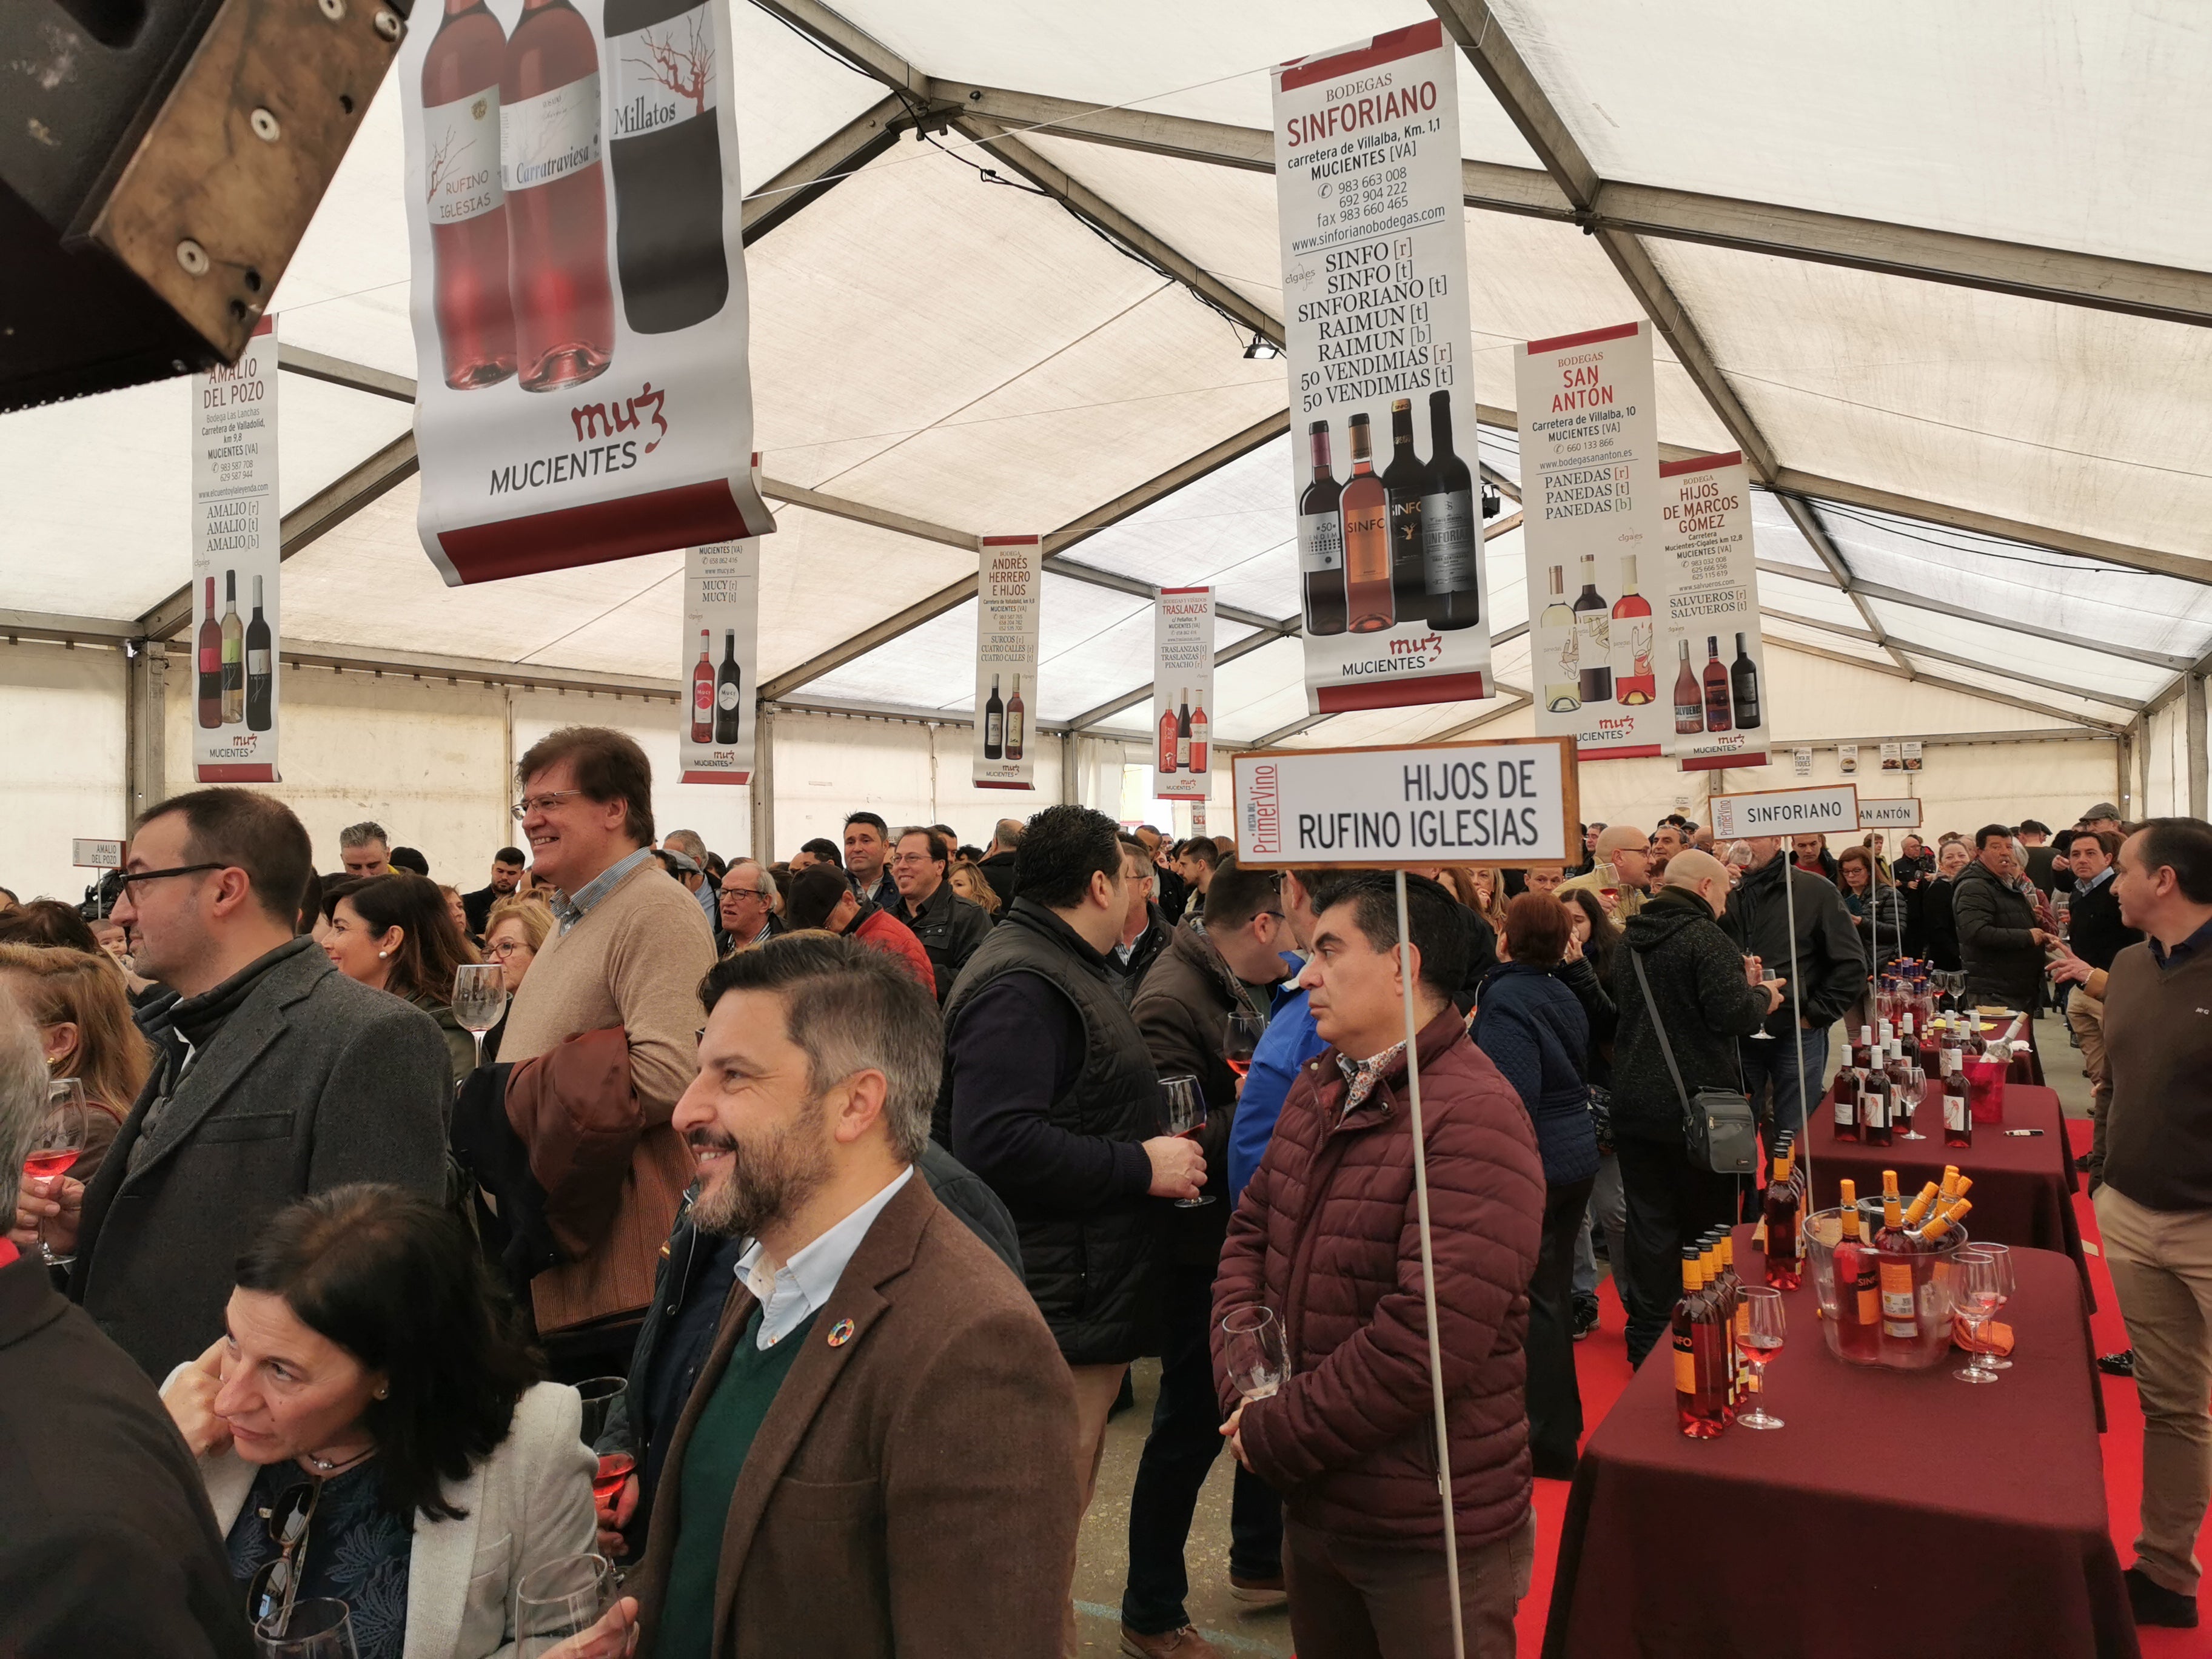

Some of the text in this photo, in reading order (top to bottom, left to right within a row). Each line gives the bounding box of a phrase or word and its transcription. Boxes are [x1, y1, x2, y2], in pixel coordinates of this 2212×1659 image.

[1326, 73, 1392, 102] BODEGAS
[614, 96, 676, 135] Millatos
[1287, 81, 1436, 147] SINFORIANO
[1288, 118, 1440, 169] carretera de Villalba, Km. 1,1
[517, 146, 589, 183] Carratraviesa
[1311, 141, 1416, 181] MUCIENTES [VA]
[446, 170, 489, 195] RUFINO
[1338, 167, 1407, 195] 983 663 008
[1339, 182, 1407, 208] 692 904 222
[440, 194, 491, 218] IGLESIAS
[1317, 196, 1409, 228] fax 983 660 465
[1292, 206, 1446, 252] www.sinforianobodegas.com
[1325, 236, 1412, 273] SINFO [r]
[1327, 260, 1413, 295] SINFO [t]
[1298, 275, 1447, 323] SINFORIANO [t]
[1318, 301, 1428, 341] RAIMUN [t]
[1318, 323, 1431, 363] RAIMUN [b]
[1301, 342, 1452, 391] 50 VENDIMIAS [r]
[1558, 352, 1604, 367] BODEGAS
[209, 358, 256, 384] AMALIO
[1563, 365, 1599, 388] SAN
[204, 380, 264, 409] DEL POZO
[1303, 365, 1453, 413] 50 VENDIMIAS [t]
[1552, 380, 1613, 413] ANTÓN
[207, 414, 226, 423] Bodega
[238, 407, 260, 418] Lanchas
[1532, 406, 1636, 432] Carretera de Villalba, 10
[202, 426, 227, 436] Carretera
[237, 418, 265, 431] Valladolid,
[1548, 422, 1621, 442] MUCIENTES [VA]
[233, 433, 242, 443] 9,8
[1567, 438, 1614, 452] 660 133 866
[208, 443, 258, 460] MUCIENTES [VA]
[1540, 449, 1632, 470] www.bodegasananton.es
[221, 461, 241, 472] 983 587
[489, 441, 637, 495] MUCIENTES
[1545, 466, 1629, 489] PANEDAS [r]
[1683, 475, 1714, 485] BODEGA
[1546, 481, 1629, 504] PANEDAS [t]
[1680, 483, 1718, 501] HIJOS
[207, 501, 258, 518] AMALIO [r]
[1546, 497, 1632, 520] PANEDAS [b]
[1663, 496, 1738, 520] DE MARCOS
[207, 518, 258, 535] AMALIO [t]
[1321, 523, 1332, 532] 50
[1348, 518, 1385, 532] SINFO
[1679, 514, 1724, 534] GÓMEZ
[207, 534, 259, 551] AMALIO [b]
[1665, 539, 1718, 552] Mucientes-Cigales
[1688, 532, 1717, 540] Carretera
[992, 555, 1027, 569] ANDRÉS
[1677, 545, 1731, 559] MUCIENTES [VA]
[703, 580, 728, 590] MUCY
[989, 571, 1030, 583] HERRERO
[1679, 579, 1734, 592] www.salvueros.com
[702, 592, 727, 602] MUCY
[993, 585, 1025, 595] E HIJOS
[1670, 589, 1746, 608] SALVUEROS [r]
[1162, 603, 1207, 615] TRASLANZAS
[1671, 601, 1747, 618] SALVUEROS [t]
[1342, 656, 1425, 675] MUCIENTES
[1568, 730, 1623, 742] UCIENTES
[210, 749, 249, 757] MUCIENTES
[1694, 745, 1737, 754] MUCIENTES
[1403, 759, 1537, 802] HIJOS DE
[1748, 802, 1842, 823] SINFORIANO
[1860, 807, 1910, 819] AN ANTÓN
[1299, 807, 1538, 849] RUFINO IGLESIAS
[92, 854, 116, 864] DEL POZO
[96, 844, 116, 854] AMALIO
